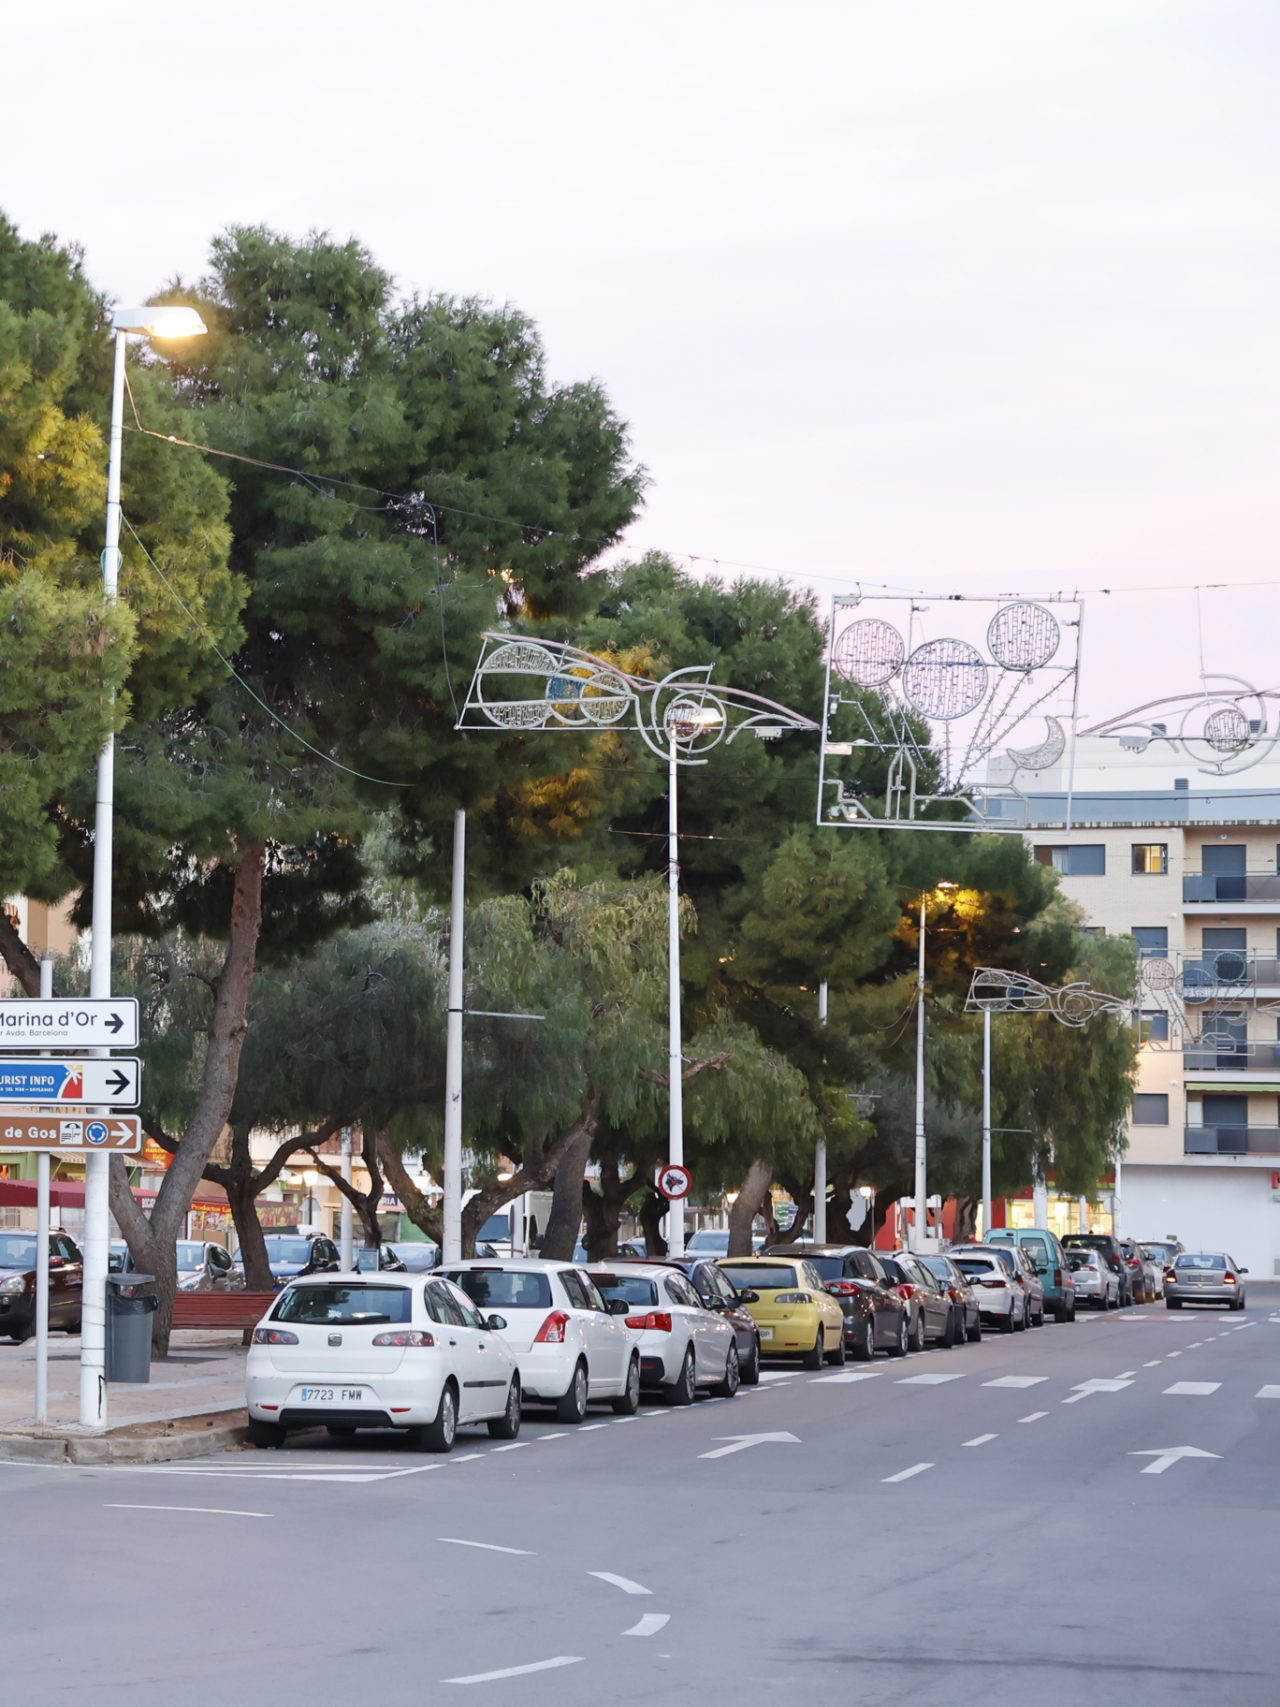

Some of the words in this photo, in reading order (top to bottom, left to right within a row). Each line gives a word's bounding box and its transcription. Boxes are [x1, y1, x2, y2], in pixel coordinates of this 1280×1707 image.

[58, 1011, 98, 1027] d'Or
[6, 1029, 27, 1037] Avda.
[29, 1029, 68, 1037] Barcelona
[30, 1075, 55, 1086] INFO
[4, 1126, 23, 1138] de
[28, 1126, 57, 1139] Gos
[307, 1389, 334, 1400] 7723
[341, 1389, 362, 1400] FMW
